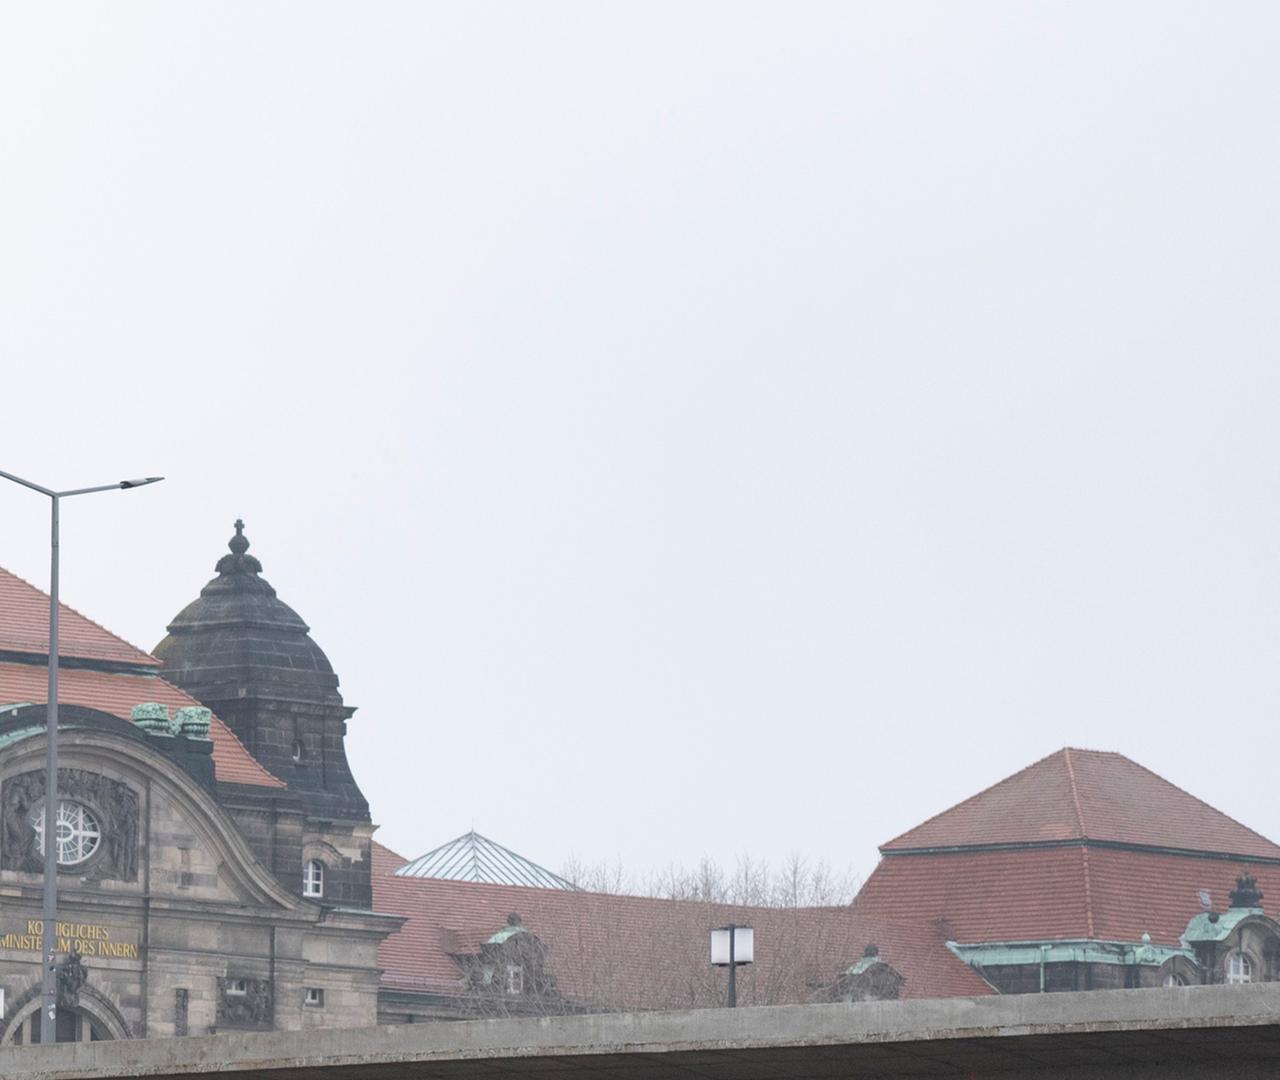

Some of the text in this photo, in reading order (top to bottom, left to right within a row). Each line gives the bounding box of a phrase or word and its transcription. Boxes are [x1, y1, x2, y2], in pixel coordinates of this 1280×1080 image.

[0, 933, 138, 958] MINISTEUM DES INNERN
